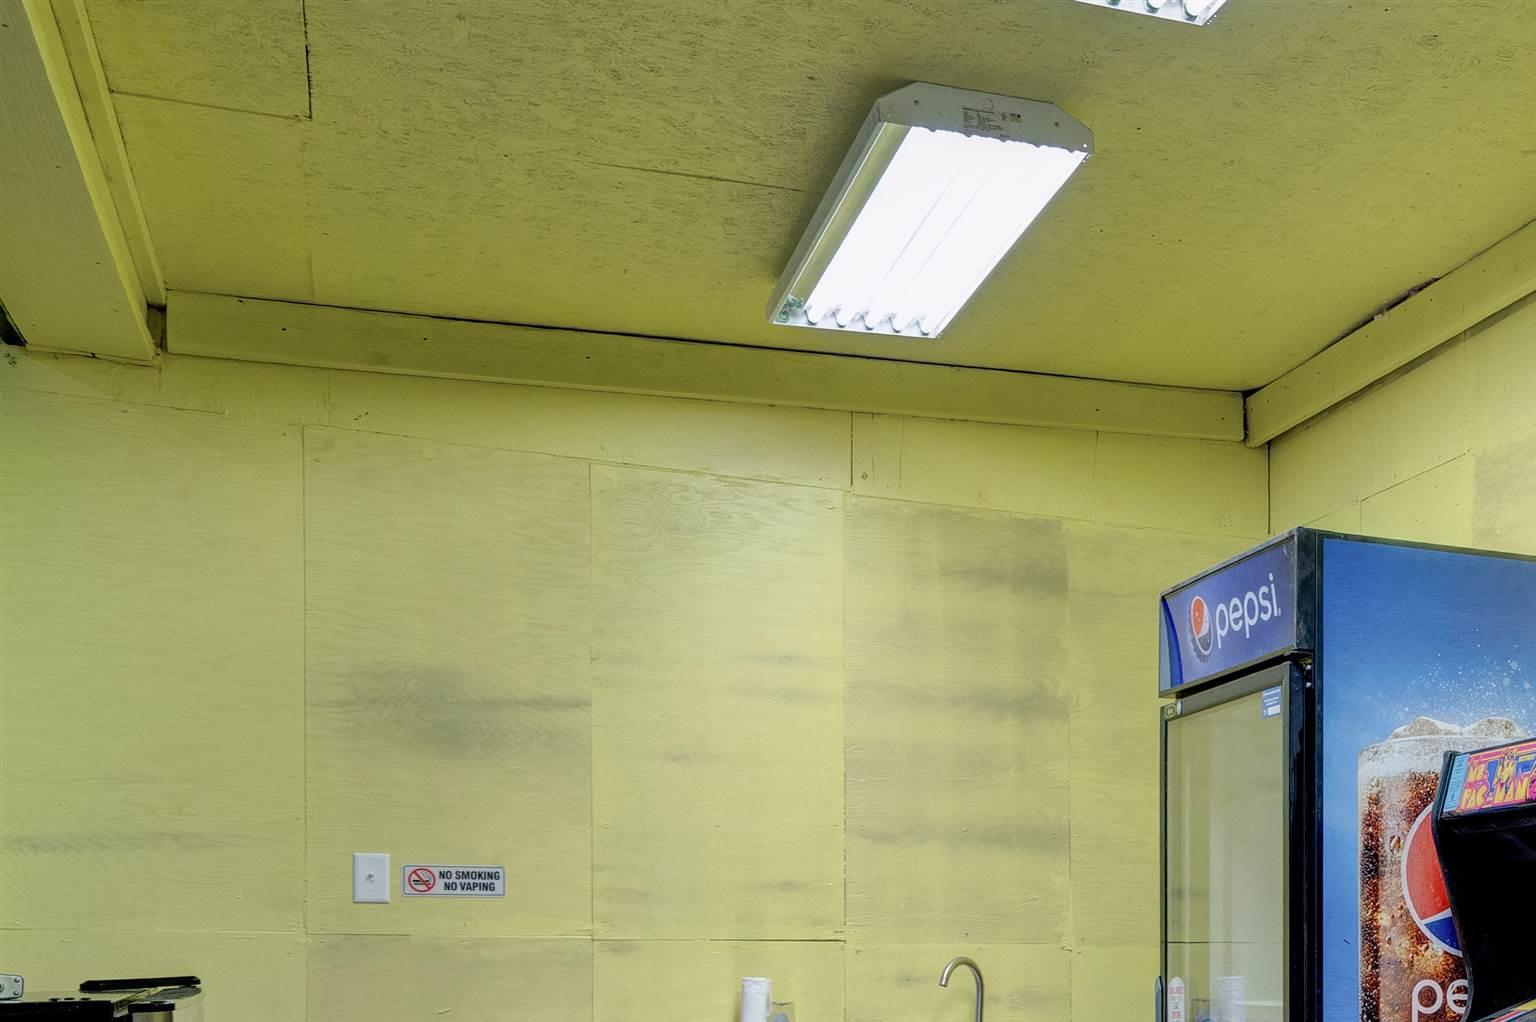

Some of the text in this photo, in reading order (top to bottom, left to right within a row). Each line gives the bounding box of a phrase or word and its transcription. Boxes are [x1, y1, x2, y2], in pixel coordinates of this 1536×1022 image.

[1215, 572, 1278, 649] pepsi
[438, 871, 500, 881] NO SMOKING
[444, 882, 495, 891] NO VAPING
